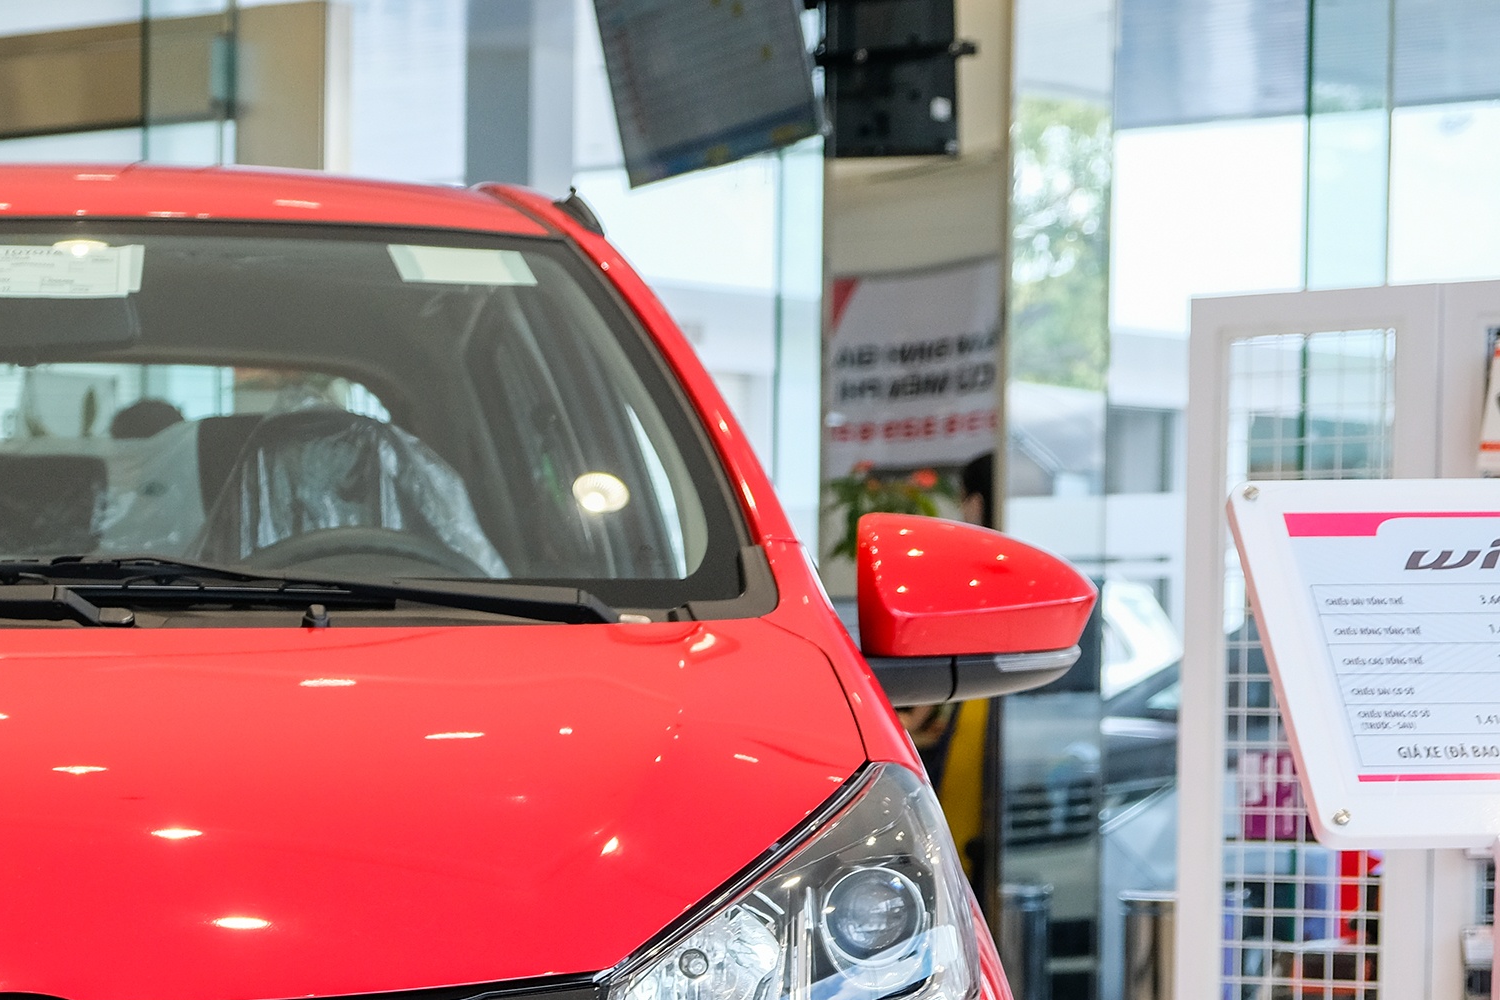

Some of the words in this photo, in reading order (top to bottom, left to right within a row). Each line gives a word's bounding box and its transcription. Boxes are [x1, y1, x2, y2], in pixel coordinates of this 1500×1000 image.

[1397, 743, 1422, 758] GIÁ
[1423, 745, 1441, 758] XE
[1471, 745, 1500, 758] BAO
